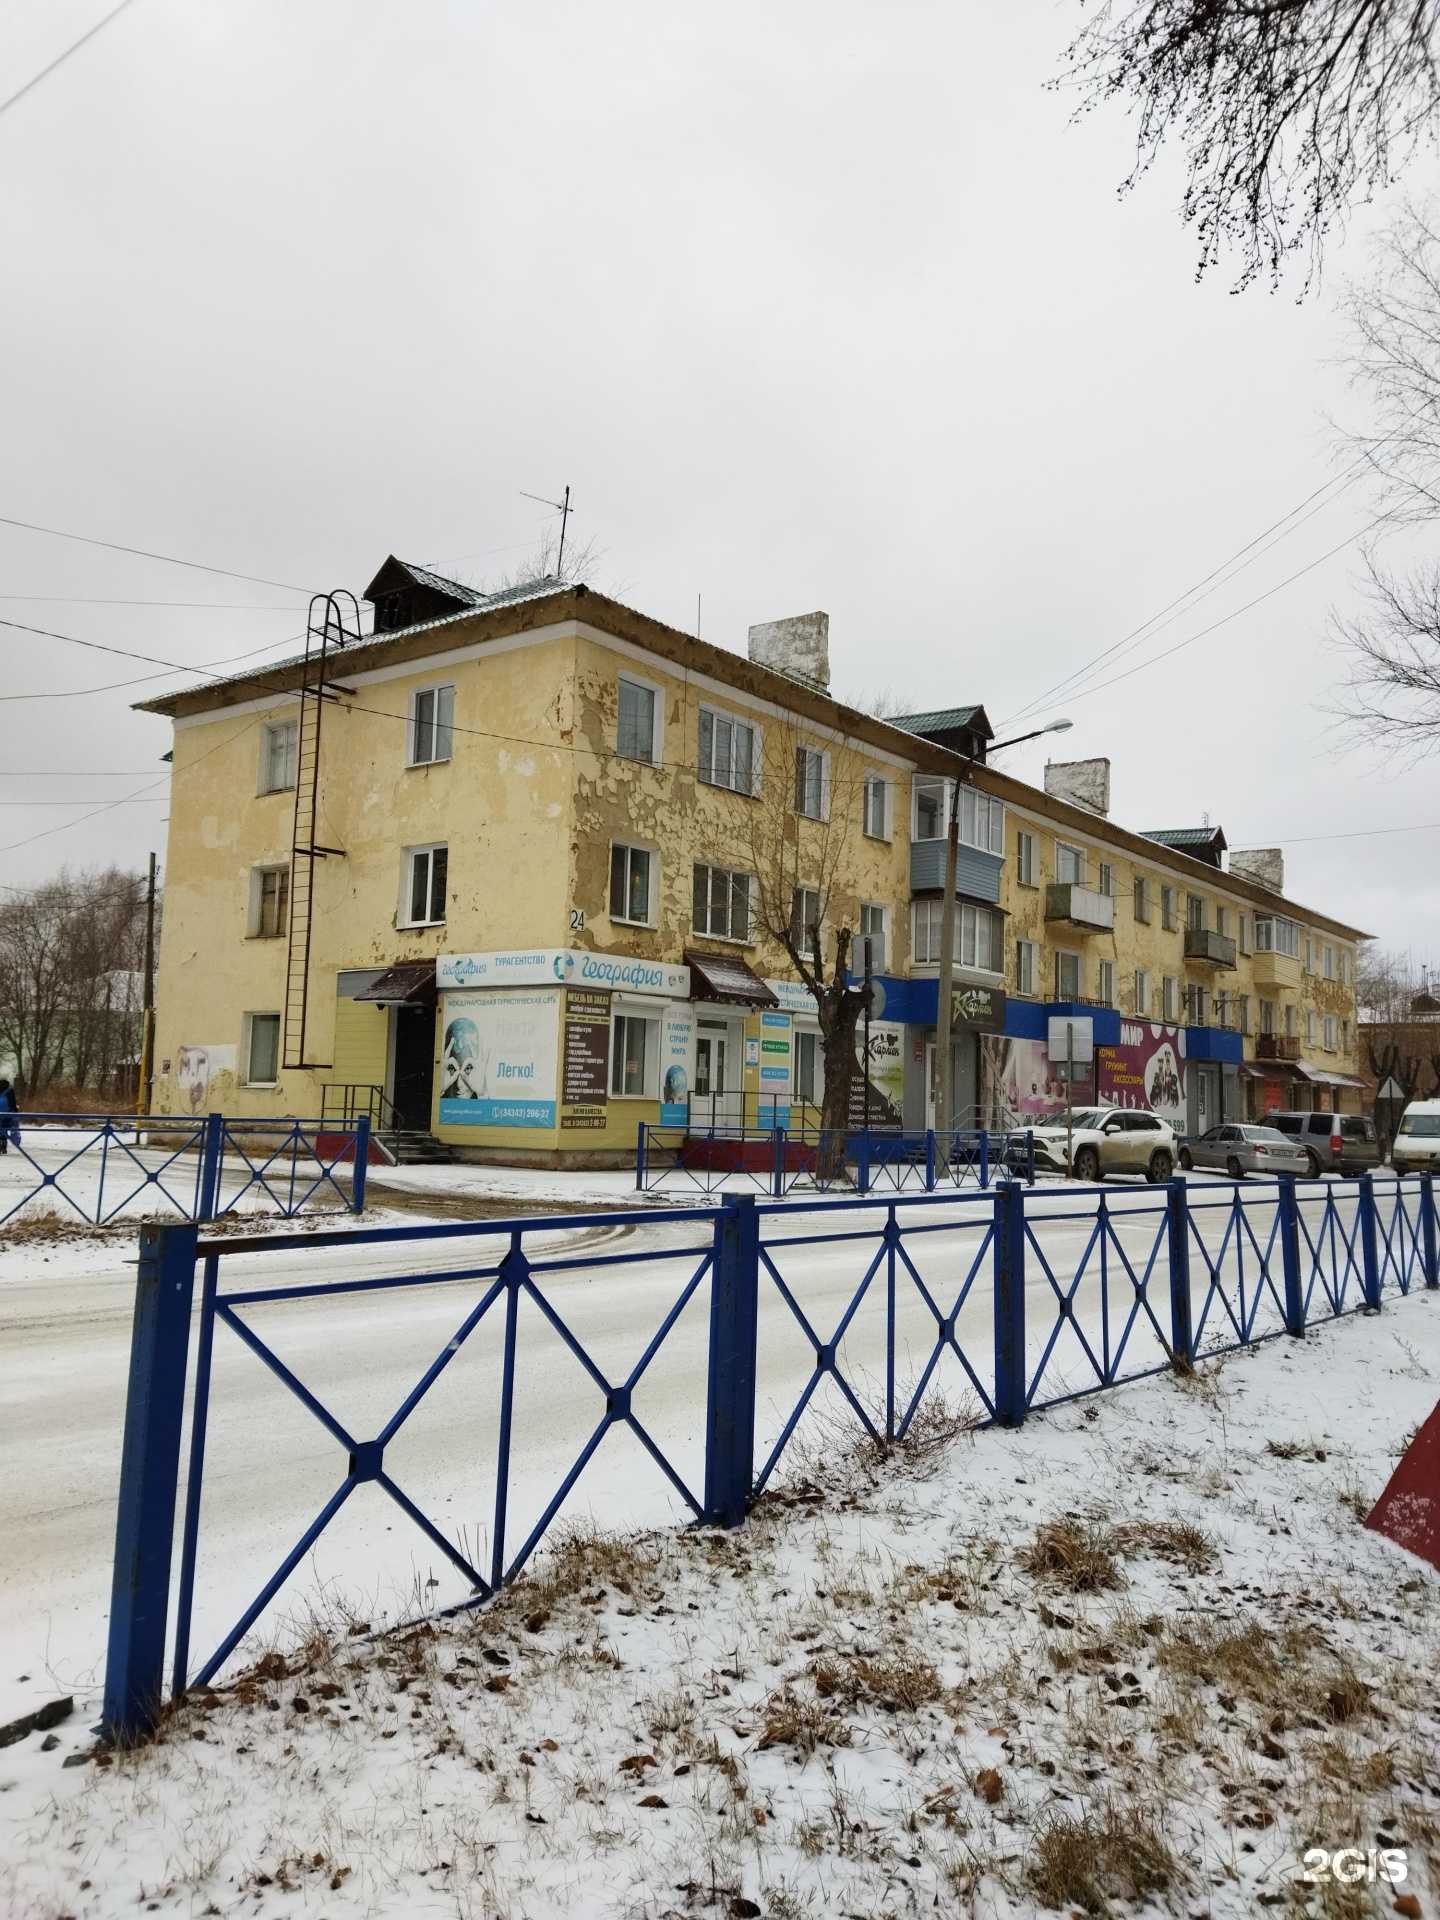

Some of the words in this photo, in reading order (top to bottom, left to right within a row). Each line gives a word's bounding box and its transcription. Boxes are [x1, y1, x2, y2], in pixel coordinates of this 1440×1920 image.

[571, 909, 585, 930] 24
[495, 955, 546, 966] ТУРАГЕНТСТВО
[1120, 1023, 1144, 1047] МИР
[496, 1062, 535, 1079] Легко!
